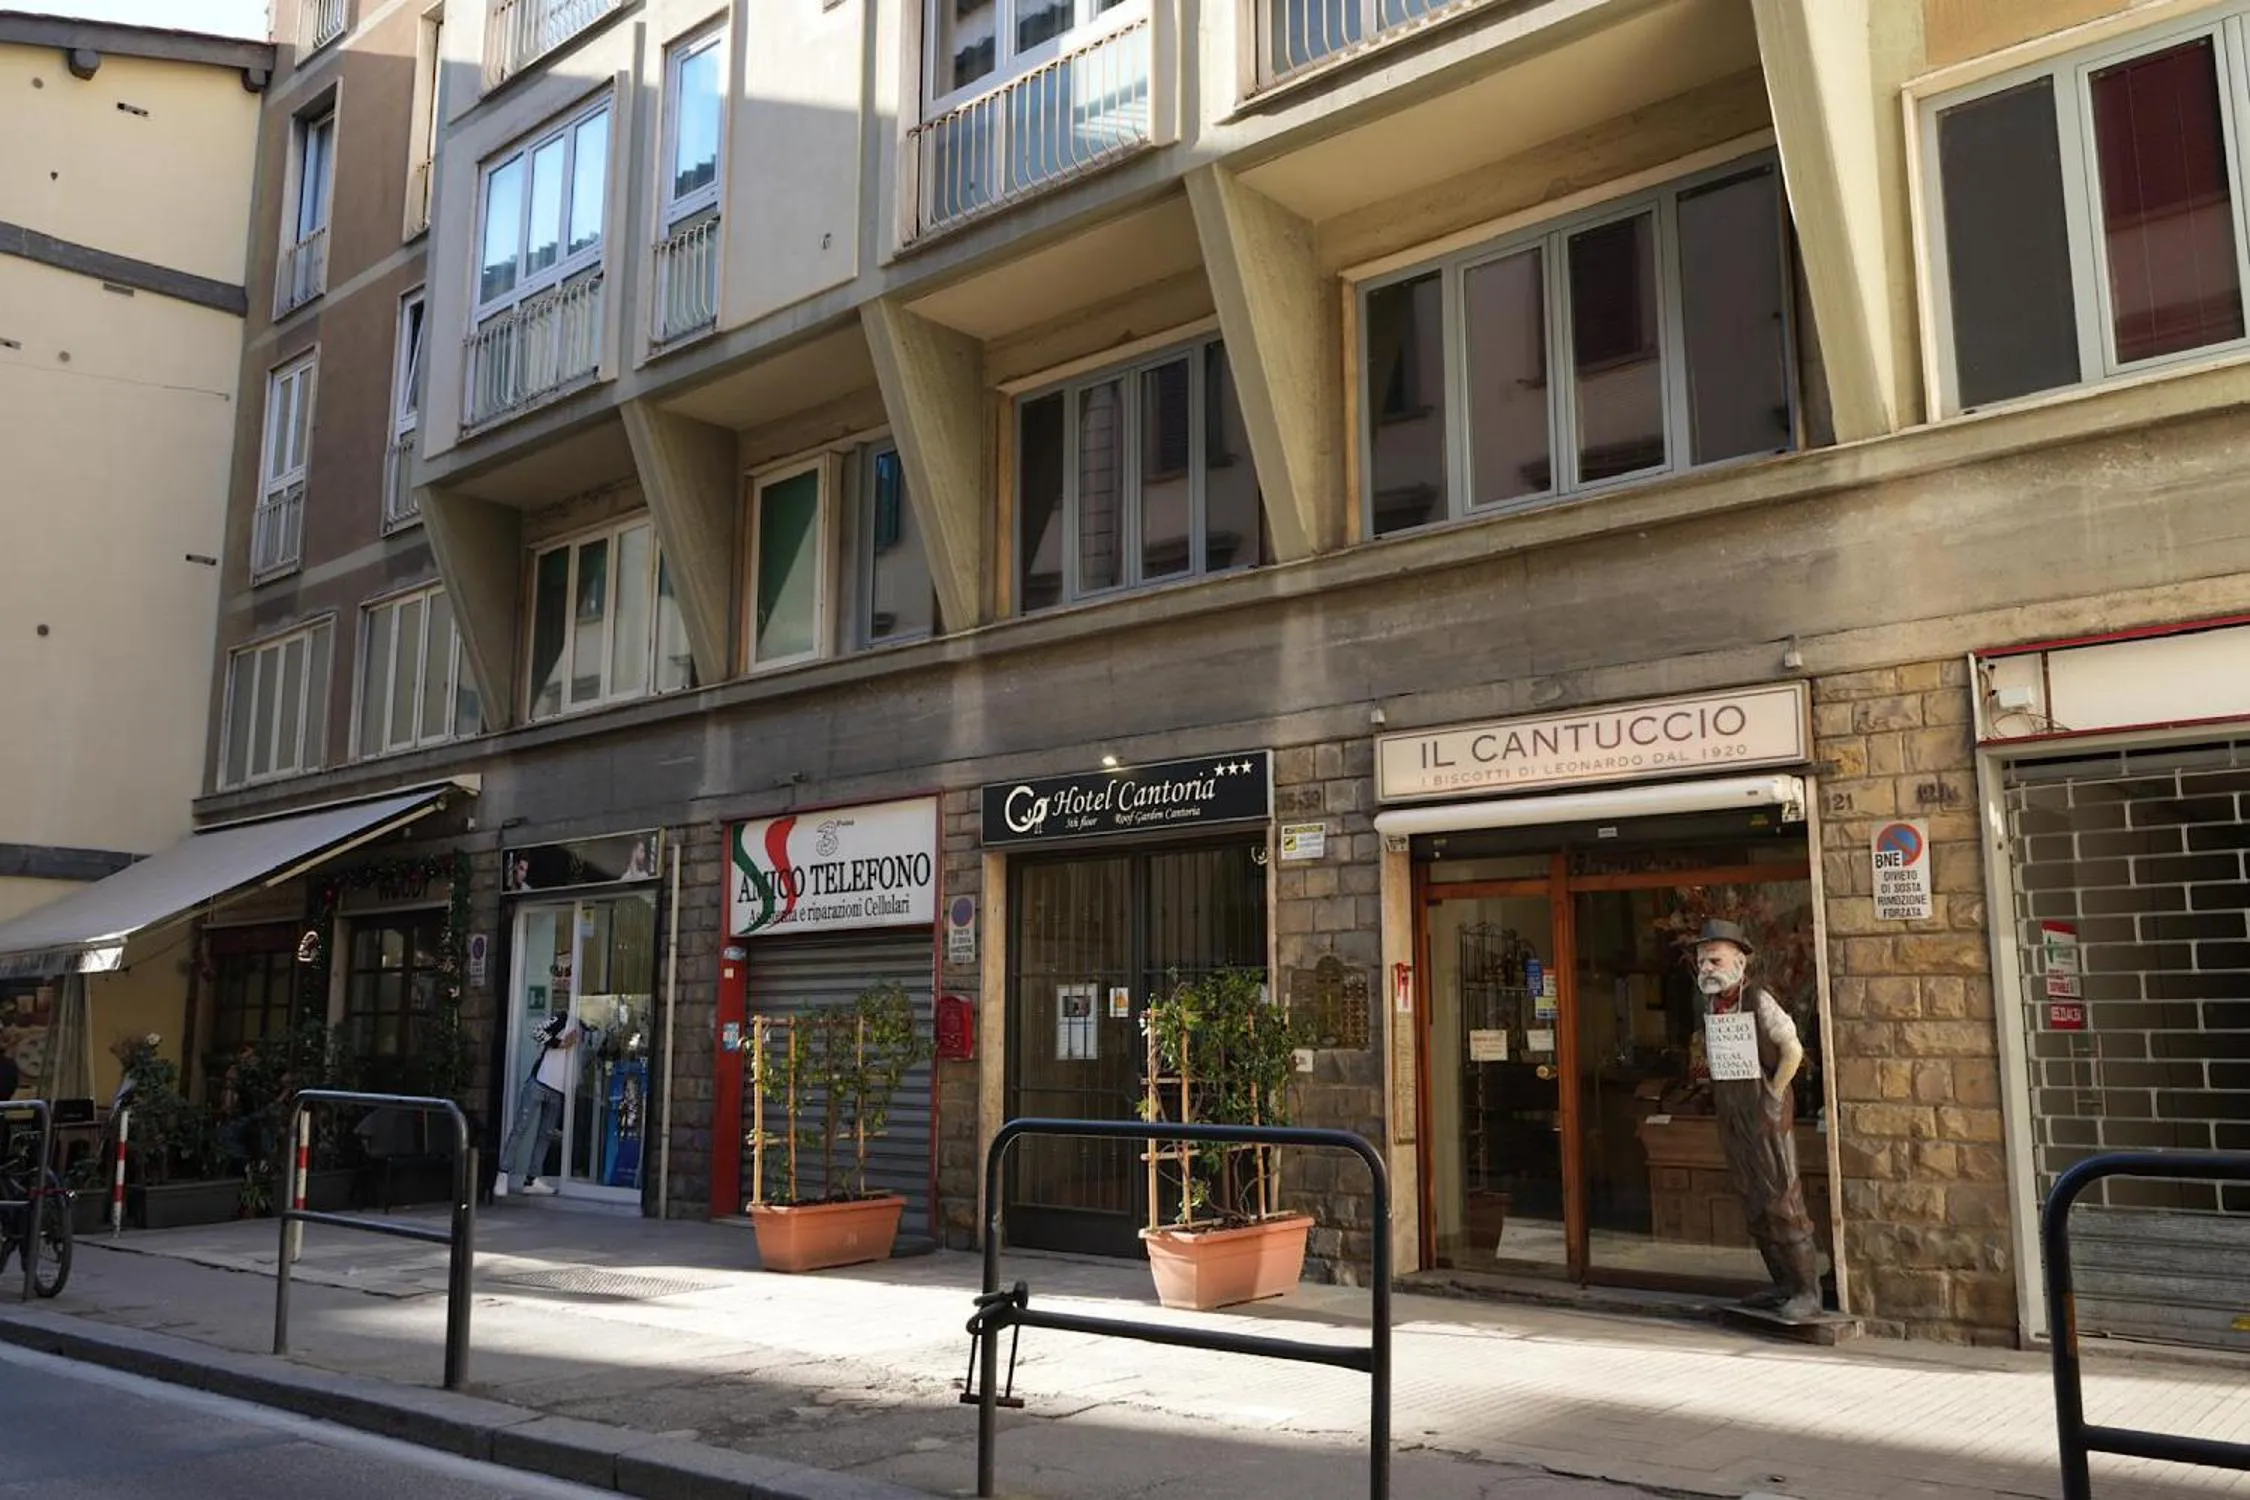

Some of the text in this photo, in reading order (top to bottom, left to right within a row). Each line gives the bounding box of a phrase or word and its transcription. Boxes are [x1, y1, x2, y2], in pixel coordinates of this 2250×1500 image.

[1420, 704, 1747, 769] IL CANTUCCIO
[1432, 768, 1511, 787] BISCOTTI
[1518, 766, 1536, 778] DI
[1544, 755, 1643, 776] LEONARDO
[1652, 749, 1689, 765] DAL
[1701, 744, 1748, 760] 1920
[1052, 771, 1216, 817] Hotel Cantoria
[1875, 852, 1900, 869] BNE
[809, 851, 931, 897] TELEFONO
[1883, 870, 1918, 882] DIVIETO
[1880, 882, 1922, 894] DI SOSTA
[799, 907, 807, 922] e
[807, 898, 863, 923] riparazioni
[864, 893, 911, 917] Cellulari
[1877, 894, 1927, 906] RIMOZIONE
[1883, 907, 1923, 919] FORZATA
